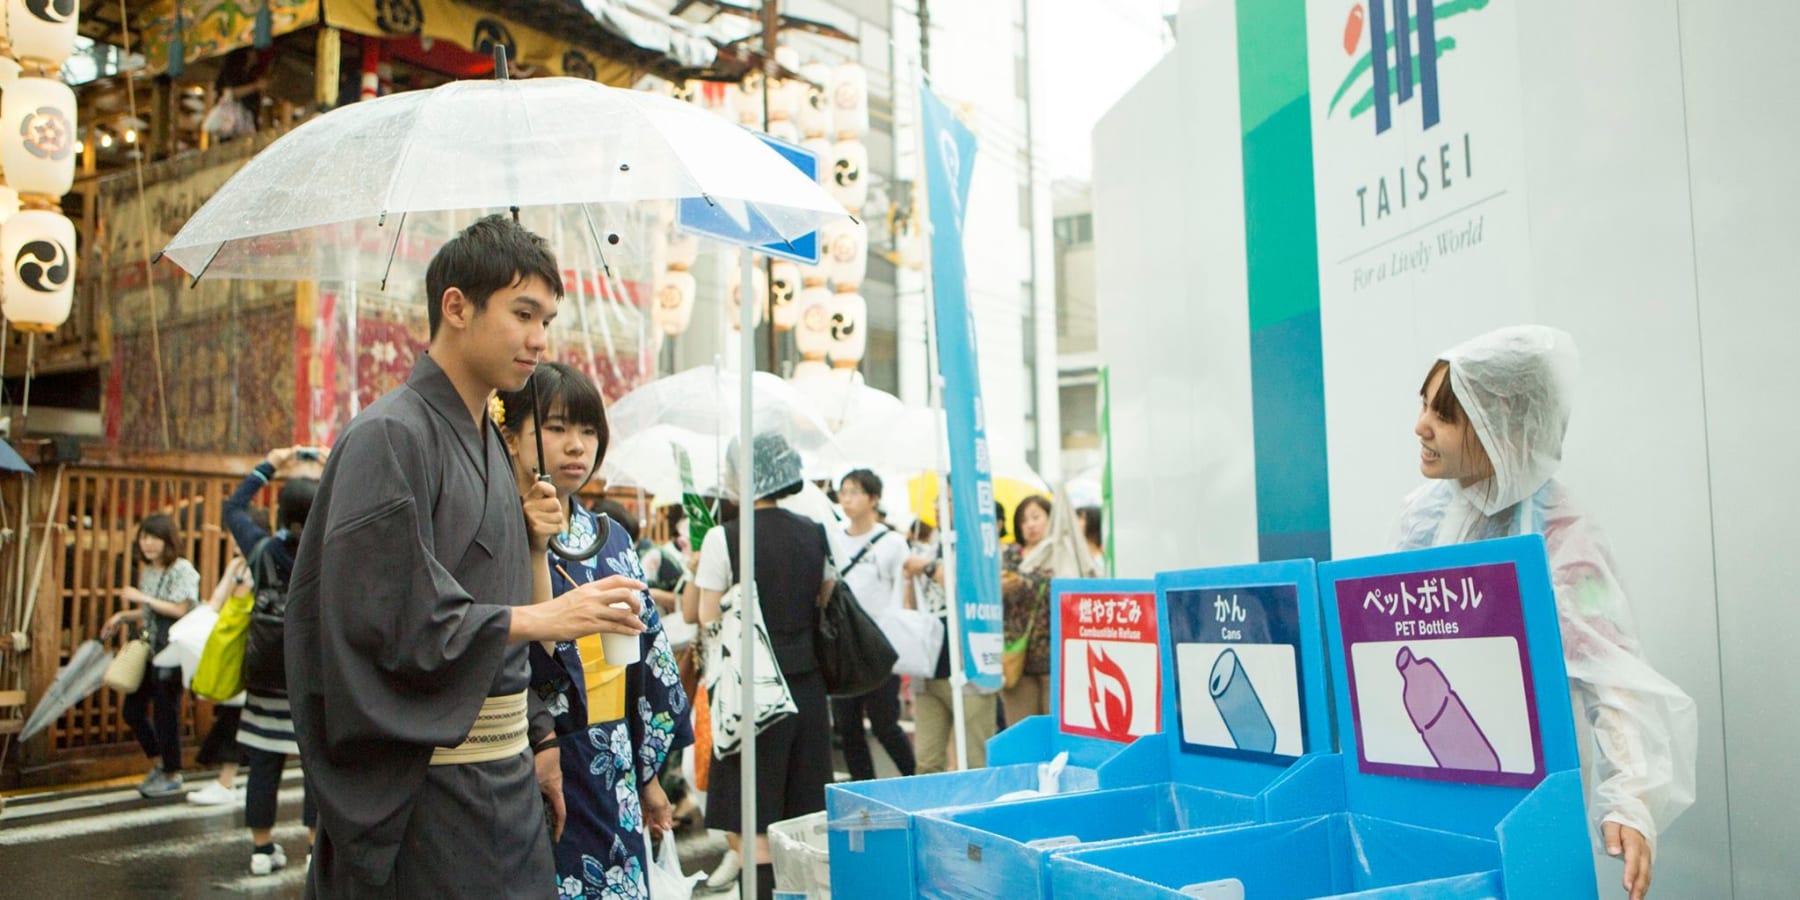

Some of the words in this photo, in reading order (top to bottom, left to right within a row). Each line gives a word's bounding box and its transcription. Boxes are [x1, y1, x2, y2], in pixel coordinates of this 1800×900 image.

[1356, 132, 1471, 227] TAISEI
[1352, 267, 1374, 292] For
[1377, 263, 1386, 282] a
[1391, 240, 1432, 276] Lively
[1437, 215, 1484, 256] World
[1213, 594, 1247, 622] かん
[1362, 577, 1483, 615] ペットボトル
[1079, 597, 1142, 624] 燃やすごみ
[1079, 626, 1117, 638] Combustible
[1118, 627, 1141, 640] Refuse
[1221, 627, 1242, 640] Cans
[1395, 620, 1416, 636] PET
[1418, 618, 1460, 635] Bottles
